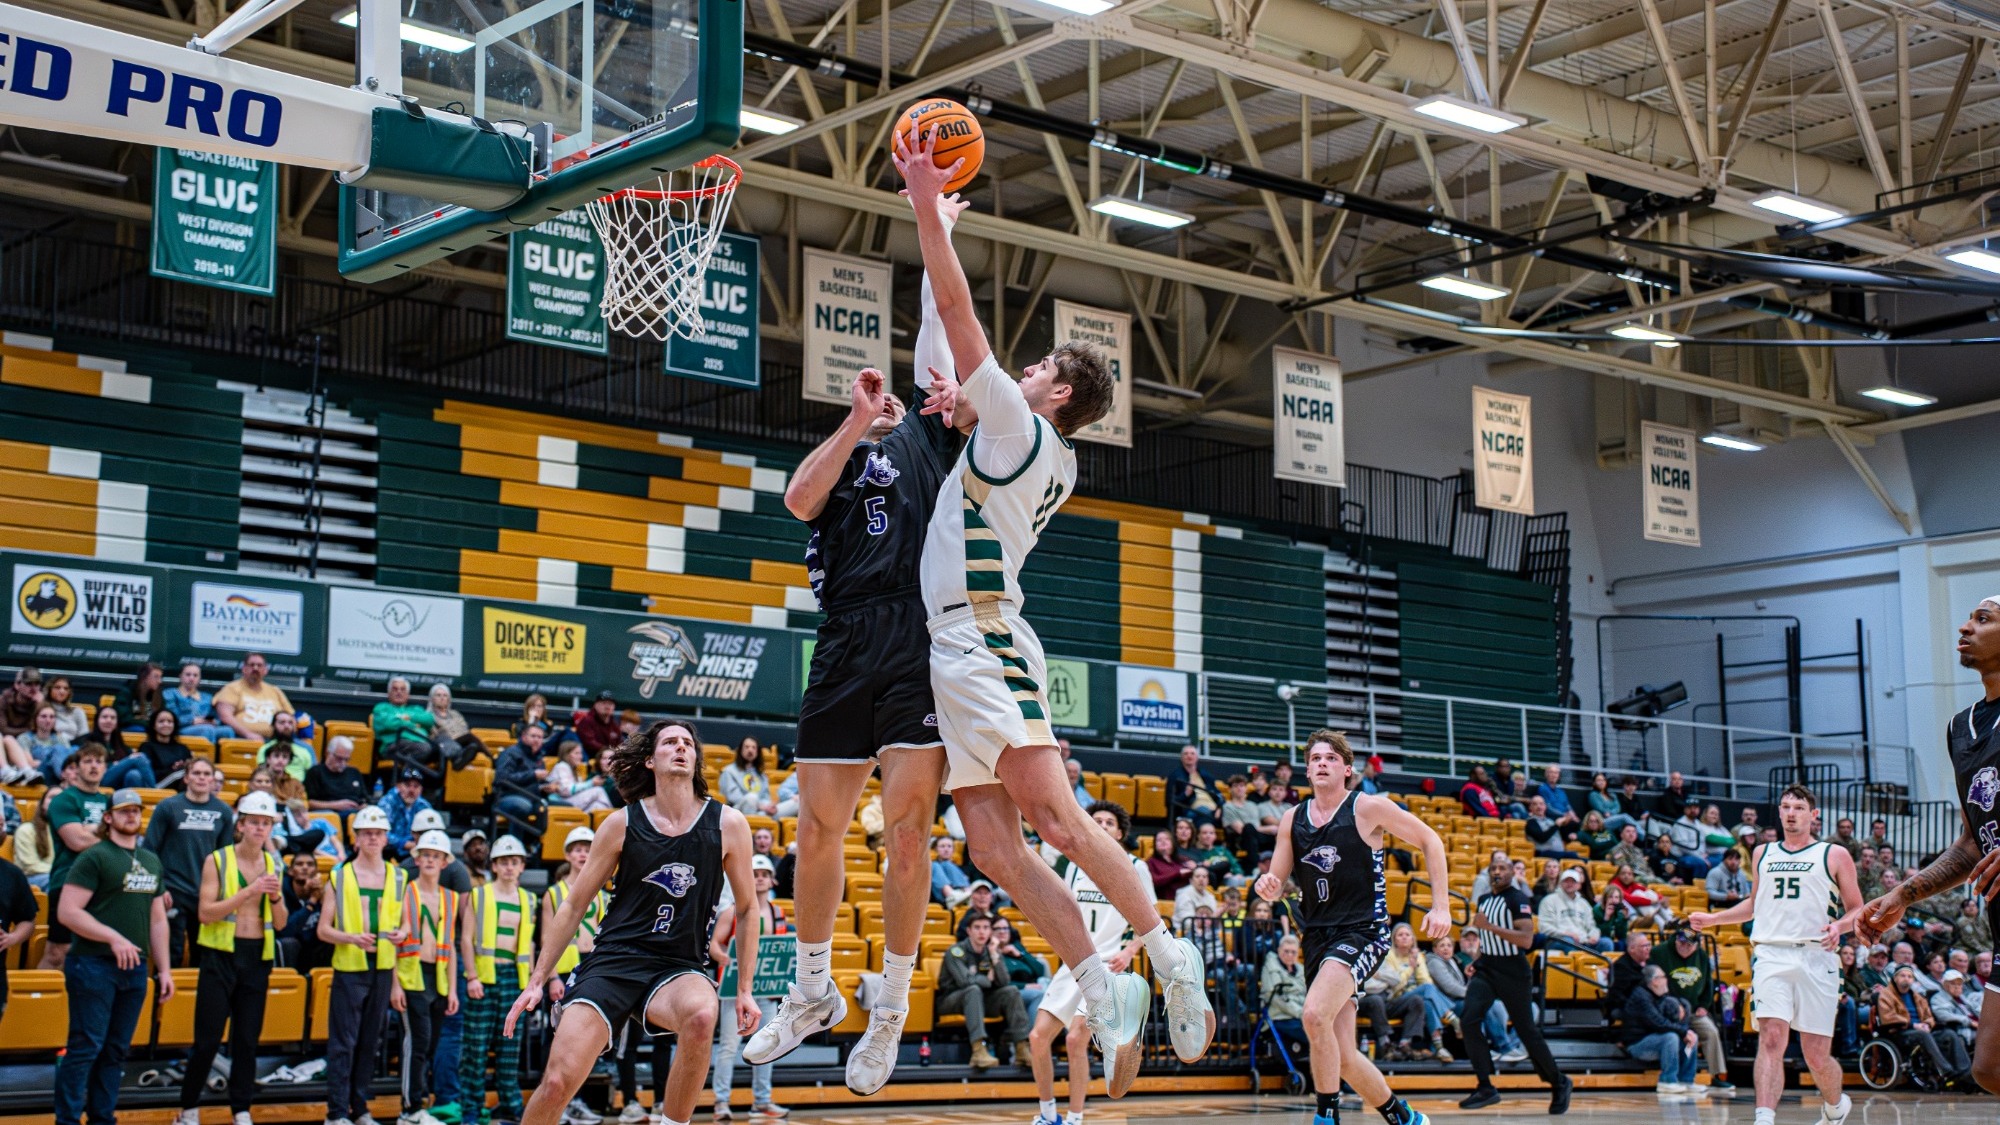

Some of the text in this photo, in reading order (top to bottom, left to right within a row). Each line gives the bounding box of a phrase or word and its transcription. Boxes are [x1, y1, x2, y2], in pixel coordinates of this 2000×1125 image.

[106, 59, 283, 147] PRO
[171, 167, 259, 214] GLVC
[177, 211, 254, 238] WEST DIVISION
[183, 229, 247, 253] CHAMPIONS
[523, 240, 596, 281] GLVC
[832, 266, 865, 284] MEN'S
[528, 281, 591, 303] WEST DIVISION
[819, 279, 878, 303] BASKETBALL
[533, 297, 586, 318] CHAMPIONS
[716, 320, 750, 338] SEASON
[815, 302, 881, 340] NCAA
[1073, 315, 1115, 333] WOMEN'S
[1295, 361, 1321, 375] MEN'S
[1285, 372, 1333, 392] BASKETBALL
[1282, 392, 1334, 425] NCAA
[1480, 429, 1525, 458] NCAA
[1655, 433, 1686, 449] WOMEN'S
[1650, 463, 1691, 491] NCAA
[864, 496, 888, 535] 5
[84, 579, 147, 596] BUFFALO
[84, 593, 146, 616] WILD
[202, 600, 297, 627] BAYMONT
[83, 613, 145, 633] WINGS
[495, 619, 575, 651] DICKEY'S
[500, 645, 568, 664] BARBECUE PIT
[703, 631, 768, 659] THIS IS
[696, 654, 760, 680] MINER
[676, 674, 752, 701] NATION
[1123, 701, 1182, 721] Days Inn
[1768, 862, 1814, 872] MINERS
[1316, 878, 1329, 902] 0
[1774, 877, 1800, 899] 35
[652, 904, 675, 934] 2
[1090, 909, 1097, 932] 1
